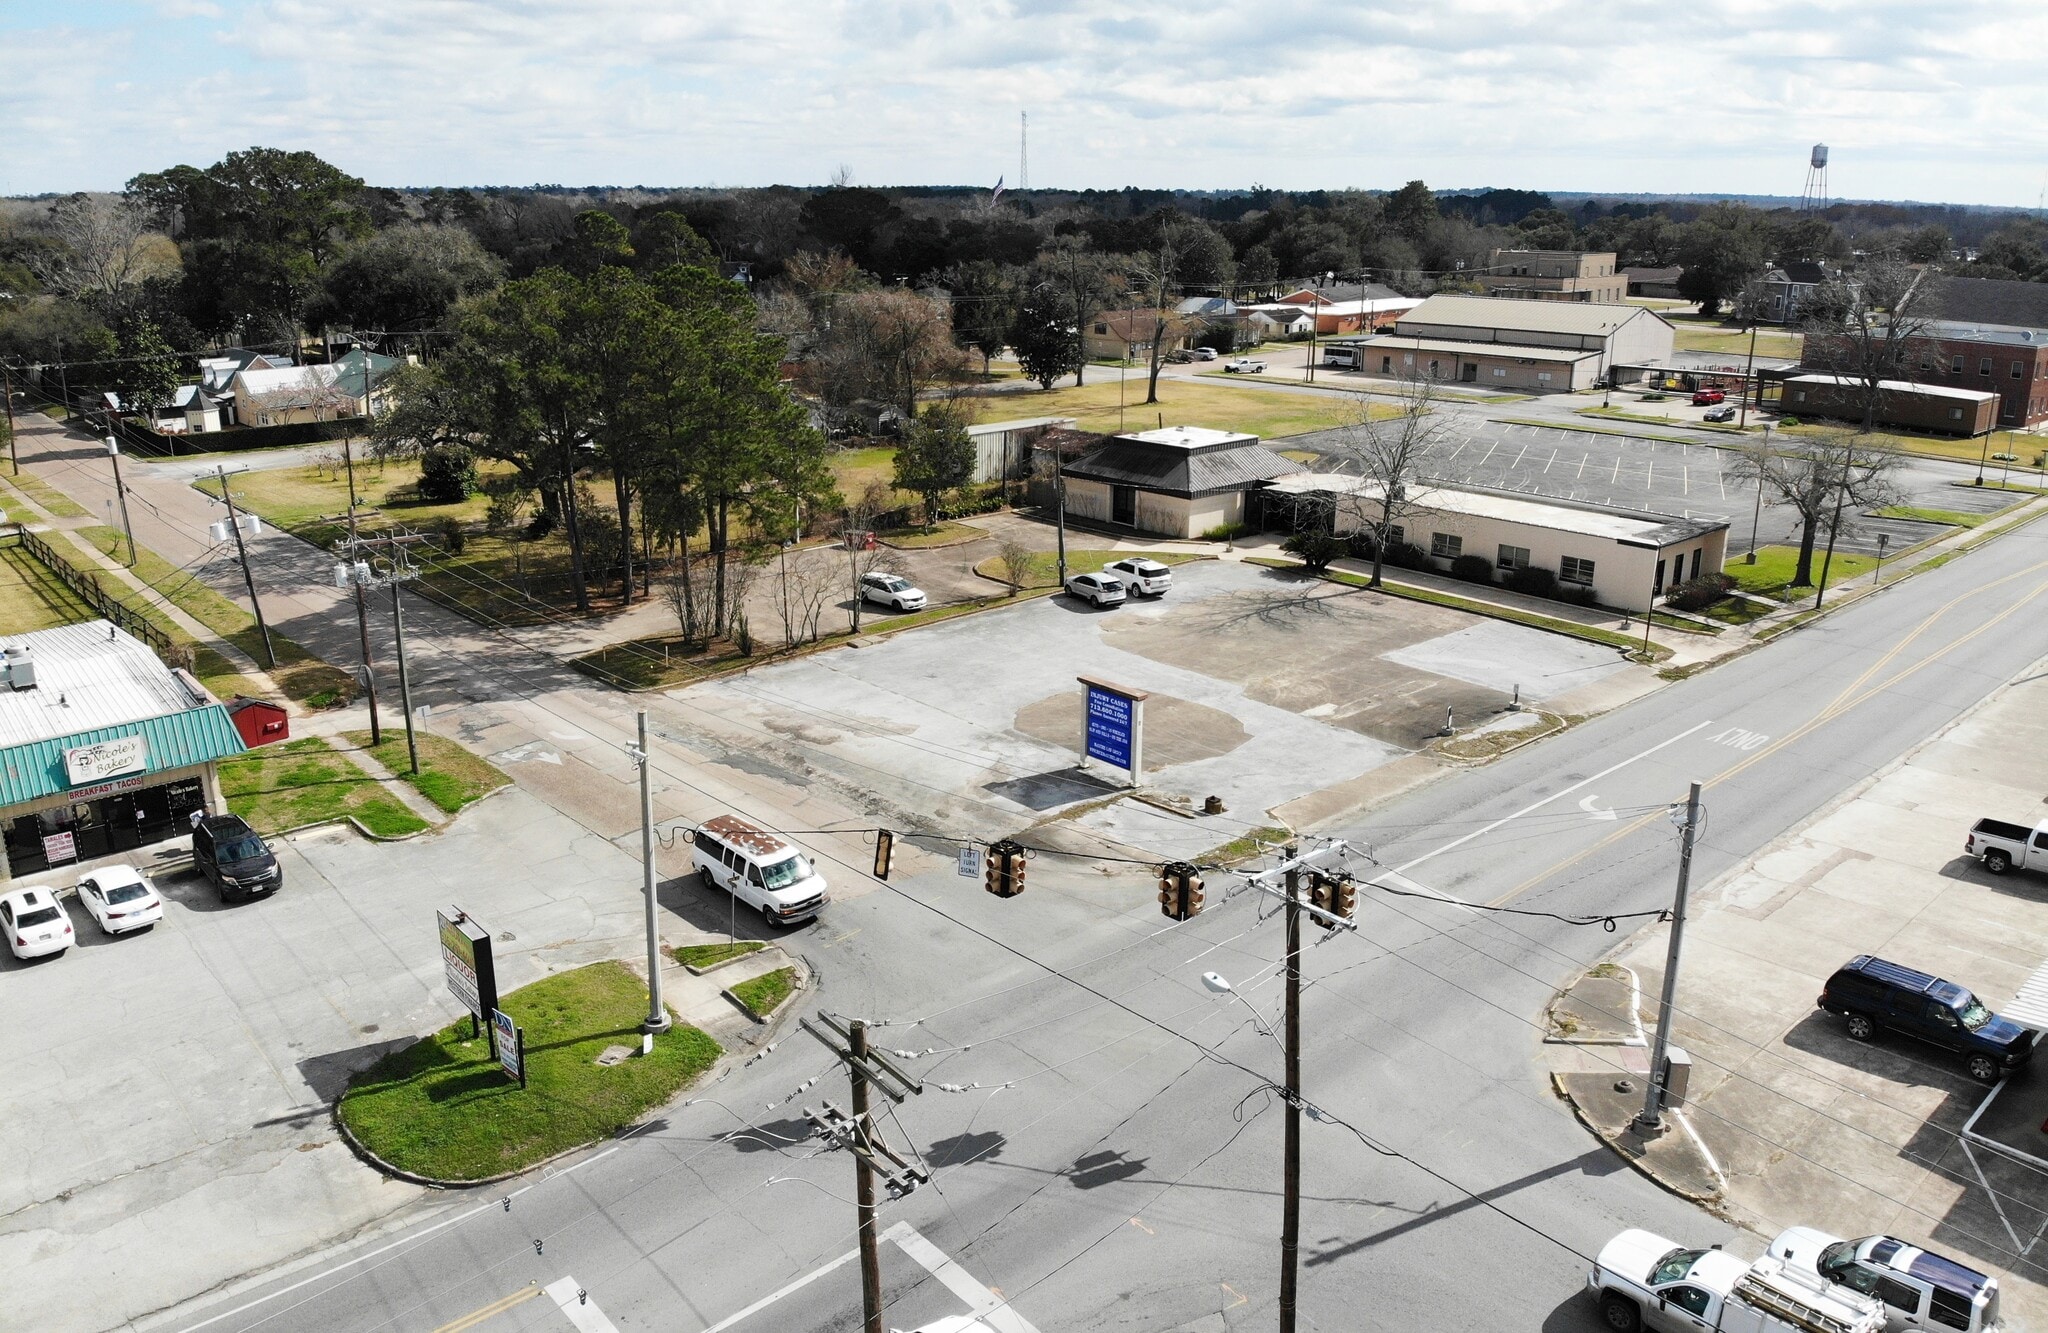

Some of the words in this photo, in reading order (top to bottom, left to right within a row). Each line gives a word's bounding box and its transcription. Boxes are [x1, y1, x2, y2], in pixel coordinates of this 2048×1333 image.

[1090, 691, 1109, 702] INJURY
[1110, 698, 1128, 708] CASES
[1705, 727, 1770, 750] ONLY
[92, 741, 137, 763] Nicole's
[96, 755, 135, 774] Bakery
[69, 784, 113, 800] BREAKFAST
[117, 777, 142, 789] TACOS
[444, 947, 476, 984] LIQUOR
[499, 1040, 515, 1055] SALE
